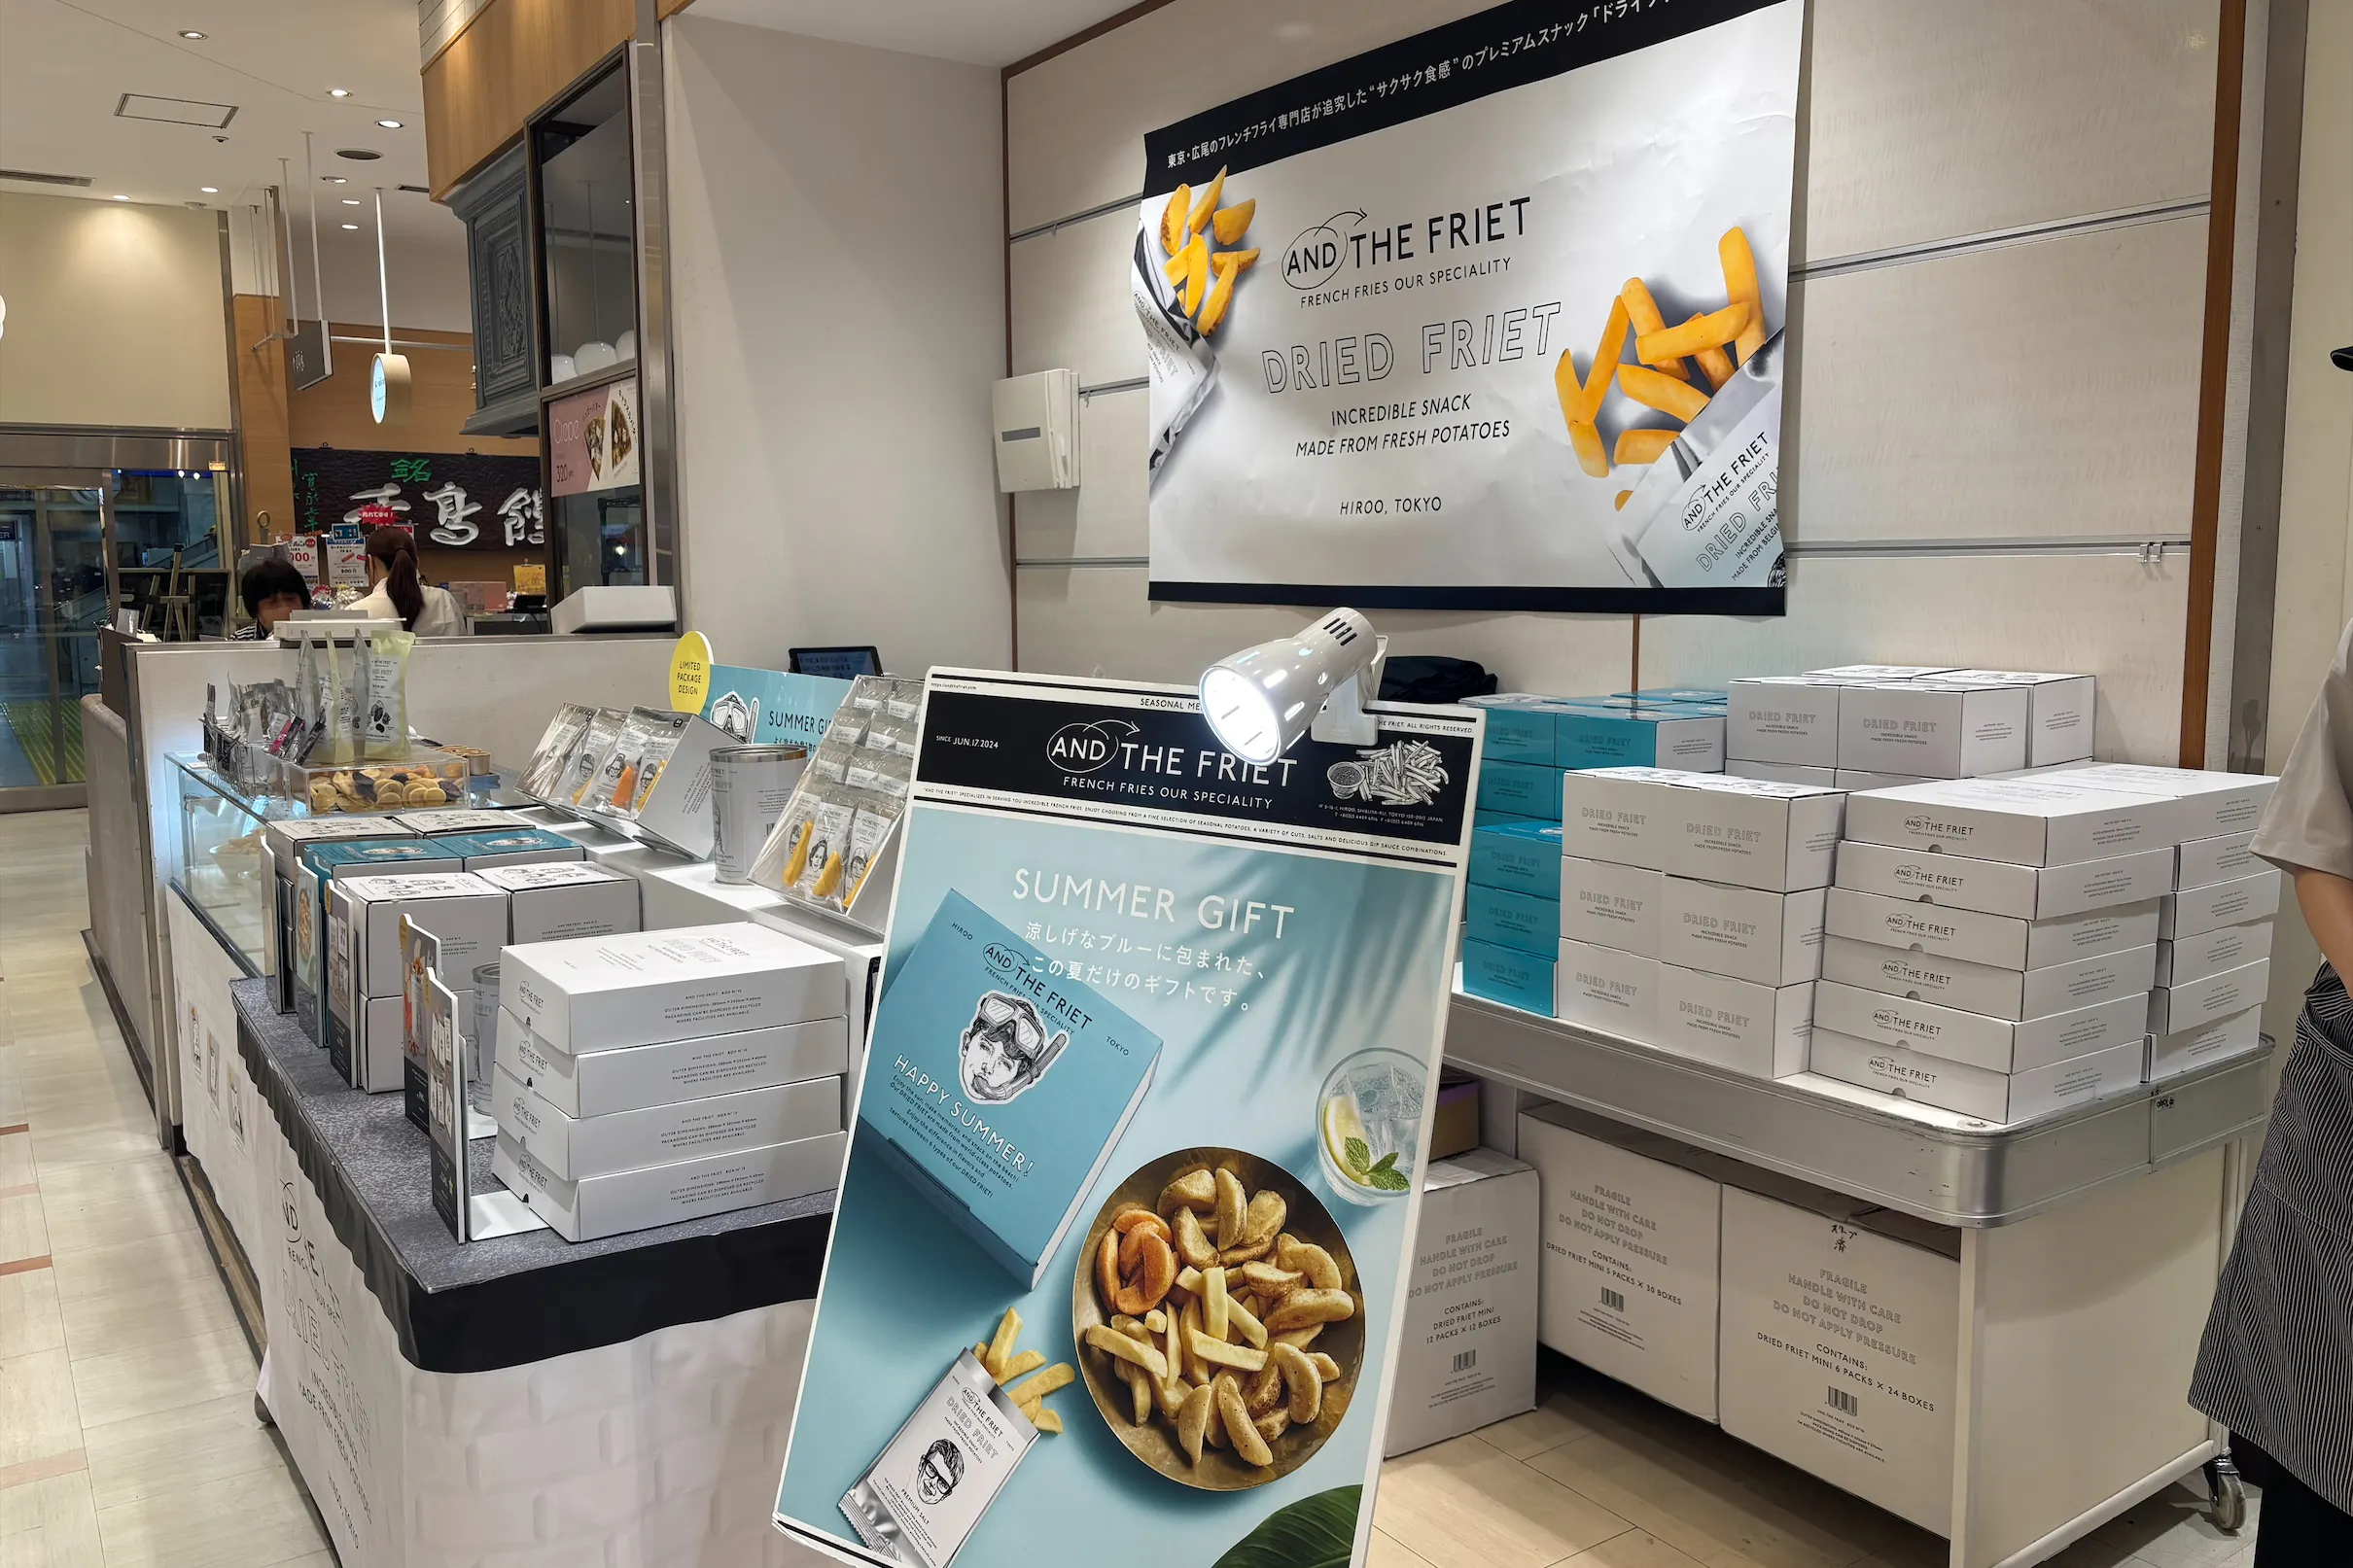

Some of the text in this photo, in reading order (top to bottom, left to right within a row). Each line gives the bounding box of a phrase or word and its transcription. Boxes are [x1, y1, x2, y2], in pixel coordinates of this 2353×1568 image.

[1167, 0, 1669, 169] 東京・広尾のフレンチフライ専門店が追究した“サクサク食感”のプレミアムスナック「ドライ
[1286, 196, 1530, 277] AND THE FRIET
[1301, 257, 1511, 308] FRENCH FRIES OUR SPECIALITY
[1262, 301, 1561, 393] DRIED FRIET
[1332, 394, 1472, 426] INCREDIBLE SNACK
[1295, 420, 1510, 457] MADE FROM FRESH POTATOES
[1684, 432, 1769, 528] AND THE FRIET
[1698, 453, 1770, 533] FRENCH FRIES OUR SPECIALITY
[1340, 496, 1442, 515] HIROO, TOKYO
[1696, 467, 1778, 572] DRIED FRI
[1732, 523, 1779, 580] MADE FROM BELGI
[1736, 521, 1767, 559] INCREDIBLE
[677, 673, 701, 683] PACKAGE
[679, 661, 701, 671] LIMITED
[678, 685, 698, 695] DESIGN
[1141, 698, 1183, 709] SEASONAL
[769, 711, 831, 735] SUMMER GI
[1749, 710, 1816, 724] DRIED FRIET
[1863, 718, 1937, 732] DRIED FRIET
[1051, 736, 1297, 787] AND THE FRIET
[1064, 776, 1273, 810] FRENCH FRIES OUR SPECIALITY
[1197, 819, 1223, 829] SEASONAL
[1224, 823, 1251, 832] POTATOES,
[1259, 827, 1280, 836] VARIETY
[1401, 845, 1448, 856] COMBINATIONS.
[1686, 823, 1762, 844] DRIED FRIET
[1905, 819, 1974, 836] AND THE FRIET
[1896, 868, 1964, 887] AND THE FRIET
[1013, 868, 1294, 939] SUMMER GIFT
[951, 922, 973, 941] HIROO
[1025, 922, 1264, 979] 涼しげなブルーに包まれた、
[984, 966, 1009, 988] FRENCH
[1040, 1007, 1075, 1035] SPECIALITY
[985, 946, 1093, 1029] AND THE FRIET
[1032, 956, 1248, 1011] この夏だけのギフトです。
[1106, 1036, 1130, 1056] TOKYO
[894, 1053, 1036, 1177] HAPPY SUMMER!
[1569, 1190, 1657, 1231] HANDLE WITH CARE
[1594, 1184, 1631, 1206] FRAGILE
[1559, 1214, 1668, 1265] DO NOT APPLY PRESSURE
[1582, 1207, 1643, 1240] DO NOT DROP
[1546, 1241, 1566, 1255] DRIED
[1567, 1249, 1587, 1263] FRIET
[1588, 1258, 1605, 1272] MINI
[1605, 1266, 1610, 1274] 5
[1612, 1269, 1635, 1287] PACKS
[1645, 1284, 1656, 1295] 30
[1656, 1289, 1682, 1307] BOXES
[1592, 1250, 1632, 1272] CONTAINS:
[1788, 1273, 1901, 1324] HANDLE WITH CARE
[1819, 1269, 1867, 1294] FRAGILE
[1773, 1301, 1916, 1365] DO NOT APPLY PRESSURE
[1803, 1296, 1883, 1334] DO NOT DROP
[1757, 1332, 1783, 1348] DRIED
[1785, 1343, 1809, 1360] FRIET
[1811, 1354, 1833, 1370] MINI
[1835, 1364, 1841, 1373] 6
[1844, 1368, 1873, 1386] PACKS
[1887, 1386, 1899, 1397] 24
[1902, 1391, 1935, 1412] BOXES
[1816, 1343, 1868, 1371] CONTAINS:
[946, 1396, 1000, 1458] DRIED FRIET
[963, 1388, 1003, 1438] AND THE FRIET
[900, 1488, 930, 1525] PREMIUM SALT
